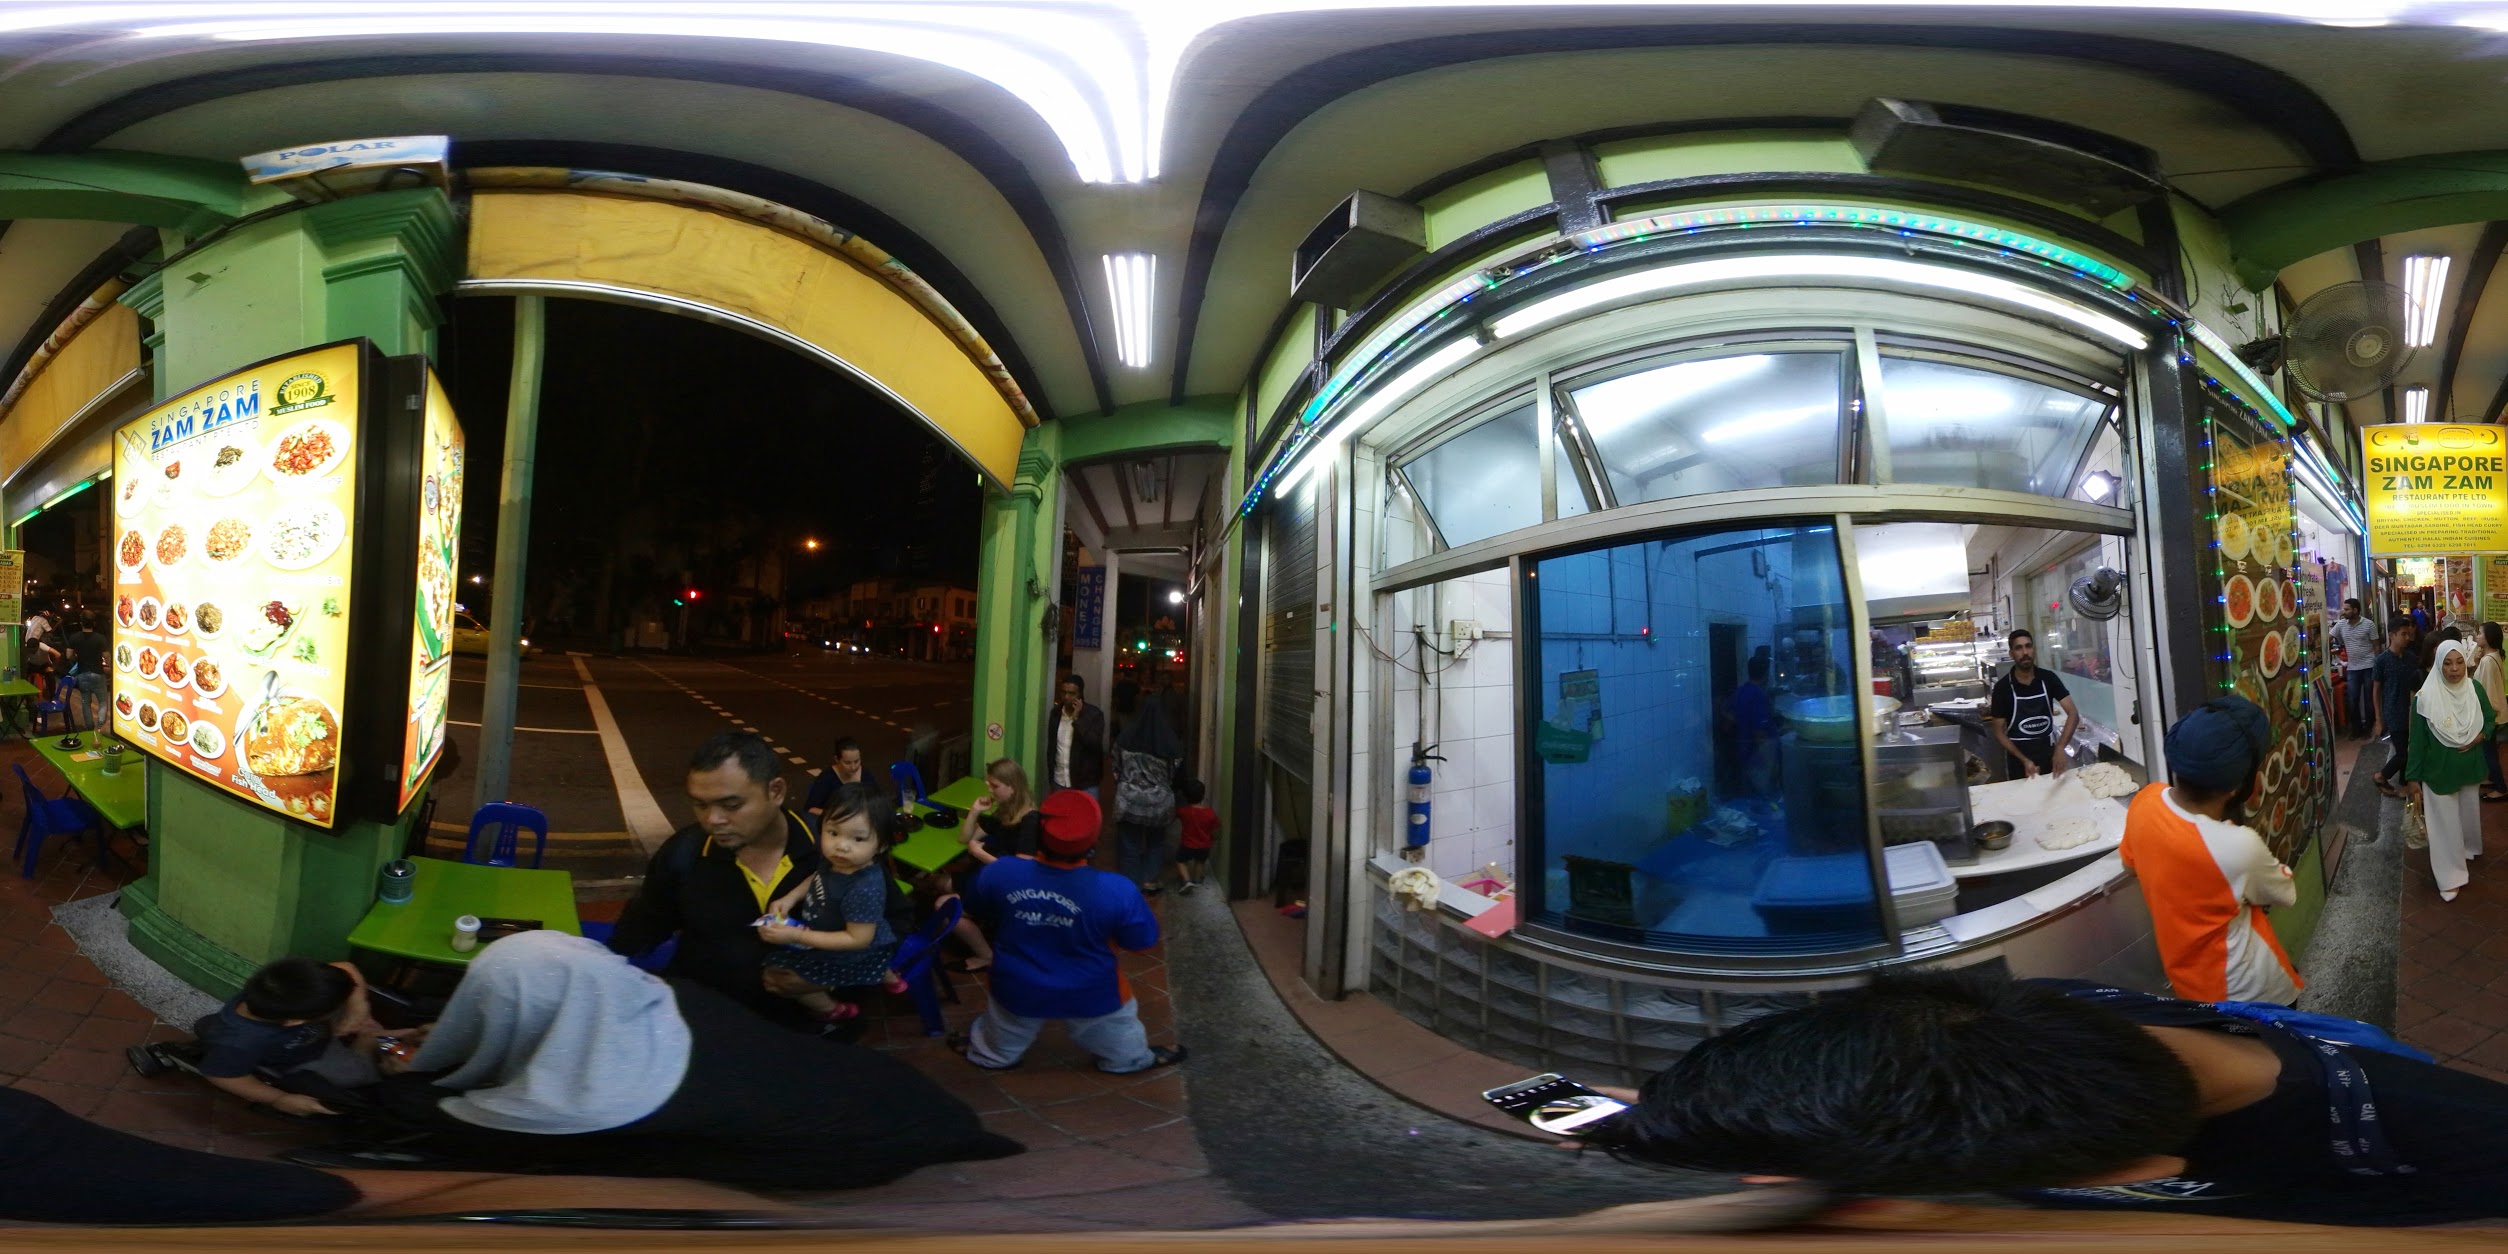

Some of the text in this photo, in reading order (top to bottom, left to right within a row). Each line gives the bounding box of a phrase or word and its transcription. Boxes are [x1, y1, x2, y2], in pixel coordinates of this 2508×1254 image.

[278, 141, 396, 161] POLAR
[280, 373, 322, 394] ESTABLISHED
[287, 385, 316, 401] 1908
[151, 380, 259, 431] SINGAPORE
[276, 399, 327, 415] MUSLIM FOOD
[151, 415, 194, 451] ZAM
[202, 392, 259, 430] ZAM
[2370, 456, 2503, 473] SINGAPORE
[2382, 475, 2493, 491] ZAM ZAM
[2452, 493, 2469, 501] PTE
[1079, 574, 1091, 635] MONEY
[231, 773, 276, 799] Fish Head
[1006, 888, 1082, 915] SINGAPORE
[1014, 909, 1042, 922] ZAM
[1046, 914, 1075, 928] ZAM
[2360, 1103, 2376, 1121] NYP
